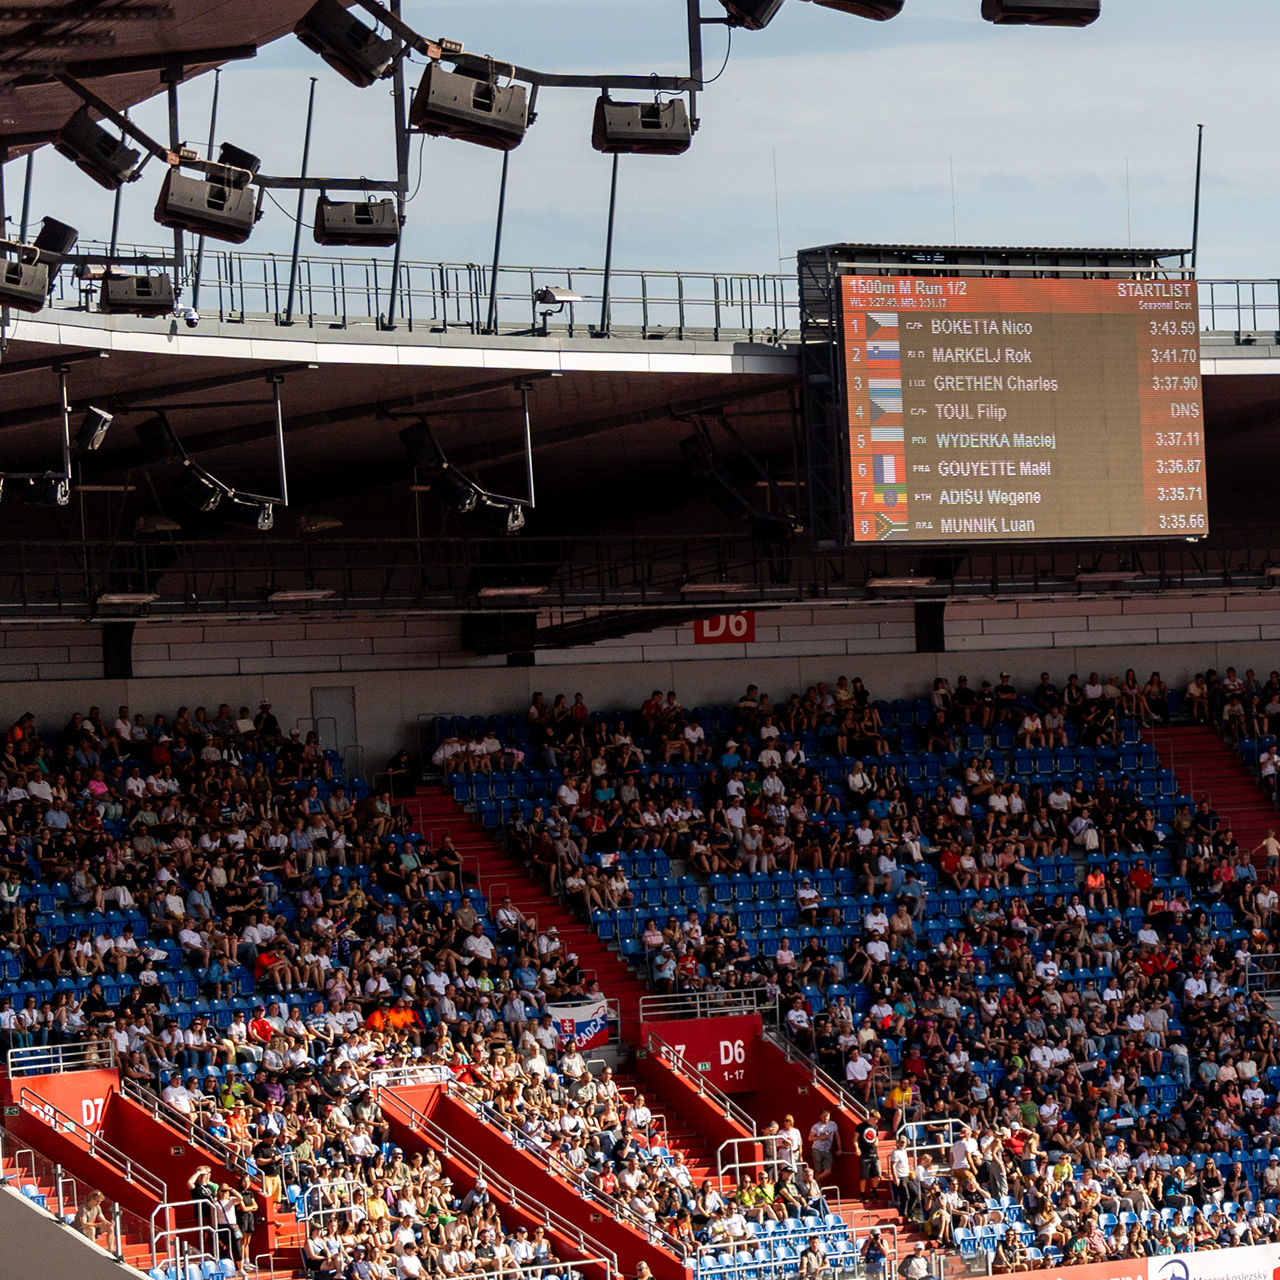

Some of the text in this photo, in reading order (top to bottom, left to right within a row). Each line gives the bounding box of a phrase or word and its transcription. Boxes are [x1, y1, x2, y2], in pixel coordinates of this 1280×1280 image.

[850, 279, 967, 295] 1500m M Run 1/2
[1117, 283, 1191, 297] STARTLIST
[851, 318, 1196, 335] 1 BOKETTA Nico 3:43.59
[852, 347, 1197, 363] 2 MARKELJ Rok 3:41.70
[854, 375, 1198, 391] 3 GRETHEN Charles 3:37.90
[855, 402, 1200, 422] 4 TOUL Filip DNS
[857, 432, 1200, 450] 5 WYDERKA Maciej 3:37.11
[858, 463, 867, 477] 6
[938, 460, 1017, 477] GOUYETTE
[1156, 459, 1202, 474] 3:36.87
[859, 486, 1203, 507] 7 ADISU Wegene 3:35.71
[860, 514, 1205, 535] 8 MUNNIK Luan 3:35.66
[720, 1039, 745, 1065] D6
[82, 1097, 104, 1126] D7
